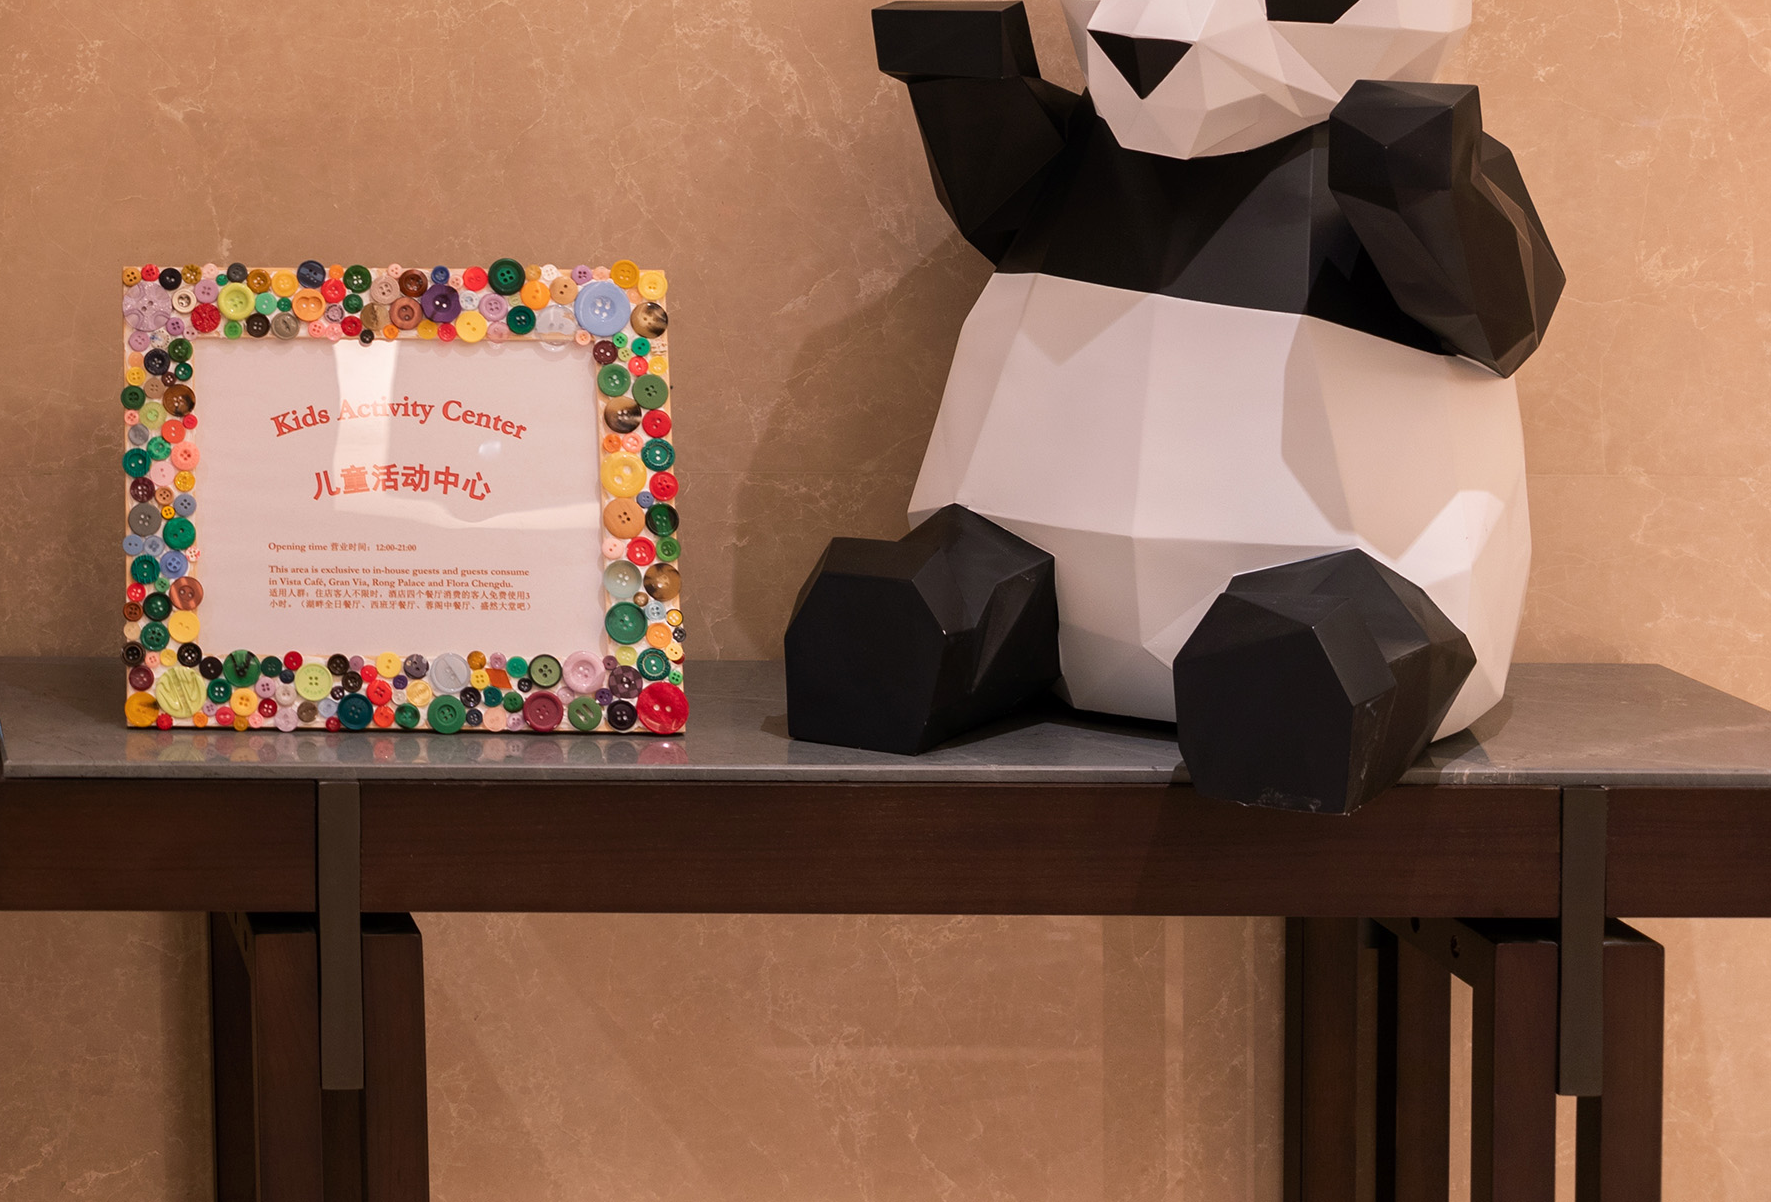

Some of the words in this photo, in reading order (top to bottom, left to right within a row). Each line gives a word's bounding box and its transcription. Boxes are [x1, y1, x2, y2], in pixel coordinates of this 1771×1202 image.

[270, 404, 330, 438] Kids
[337, 395, 435, 425] Activity
[441, 399, 528, 441] Center
[312, 463, 492, 501] 儿童活动中心
[268, 542, 306, 553] Opening
[308, 542, 328, 551] time
[268, 565, 288, 574] This
[311, 565, 319, 574] is
[321, 566, 360, 575] exclusive
[362, 567, 371, 575] to
[373, 566, 410, 575] in-house
[412, 568, 440, 577] guests
[442, 567, 459, 576] and
[460, 568, 489, 578] guests
[268, 577, 278, 586] in
[279, 577, 302, 586] Vista
[304, 577, 327, 587] Café,
[328, 578, 350, 586] Gran
[352, 578, 370, 587] Via,
[372, 578, 395, 588] Rong
[397, 578, 426, 588] Palace
[428, 579, 444, 588] and
[446, 579, 470, 588] Flora
[471, 579, 514, 590] Chengdu.
